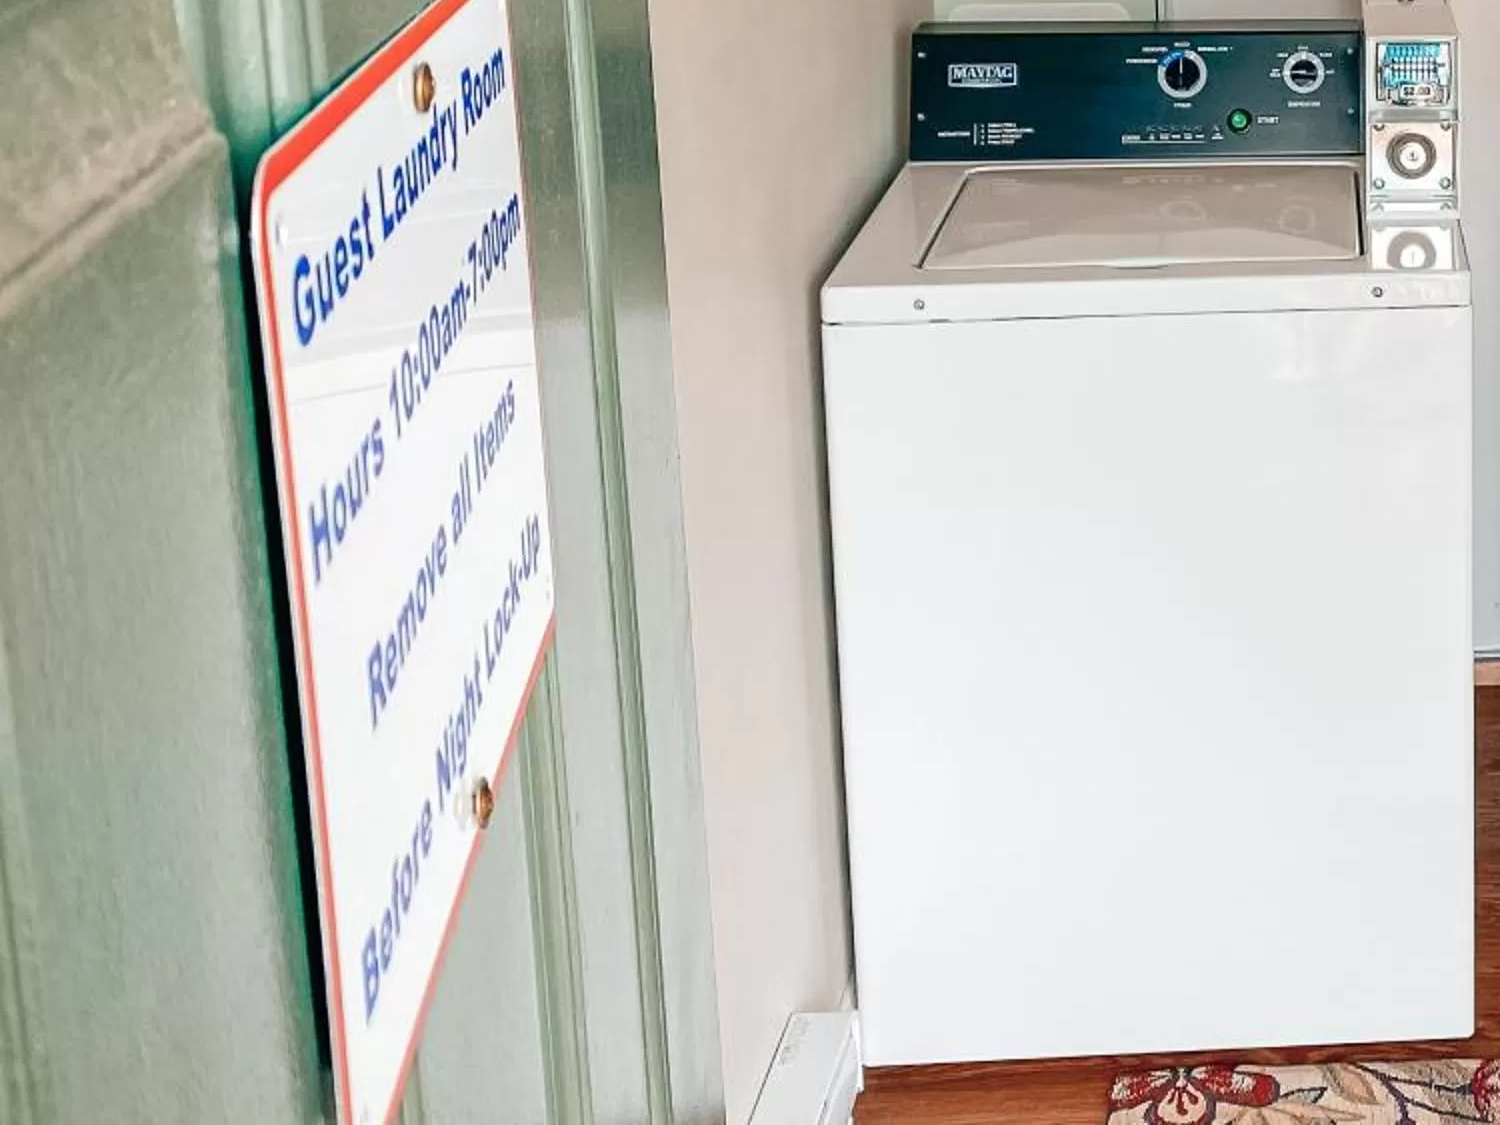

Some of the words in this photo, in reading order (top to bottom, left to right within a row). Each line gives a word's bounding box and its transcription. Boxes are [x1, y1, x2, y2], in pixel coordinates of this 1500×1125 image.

[292, 185, 374, 347] Guest
[377, 100, 458, 241] Laundry
[461, 47, 506, 136] Room
[953, 66, 1013, 79] MAYTAG
[307, 416, 386, 587] Hours
[388, 192, 522, 439] 10:00am-7:00pm
[366, 523, 448, 735] Remove
[451, 450, 473, 546] all
[473, 378, 516, 493] Items
[361, 796, 434, 1027] Before
[434, 648, 484, 813] Night
[483, 513, 541, 679] Lock-Up
